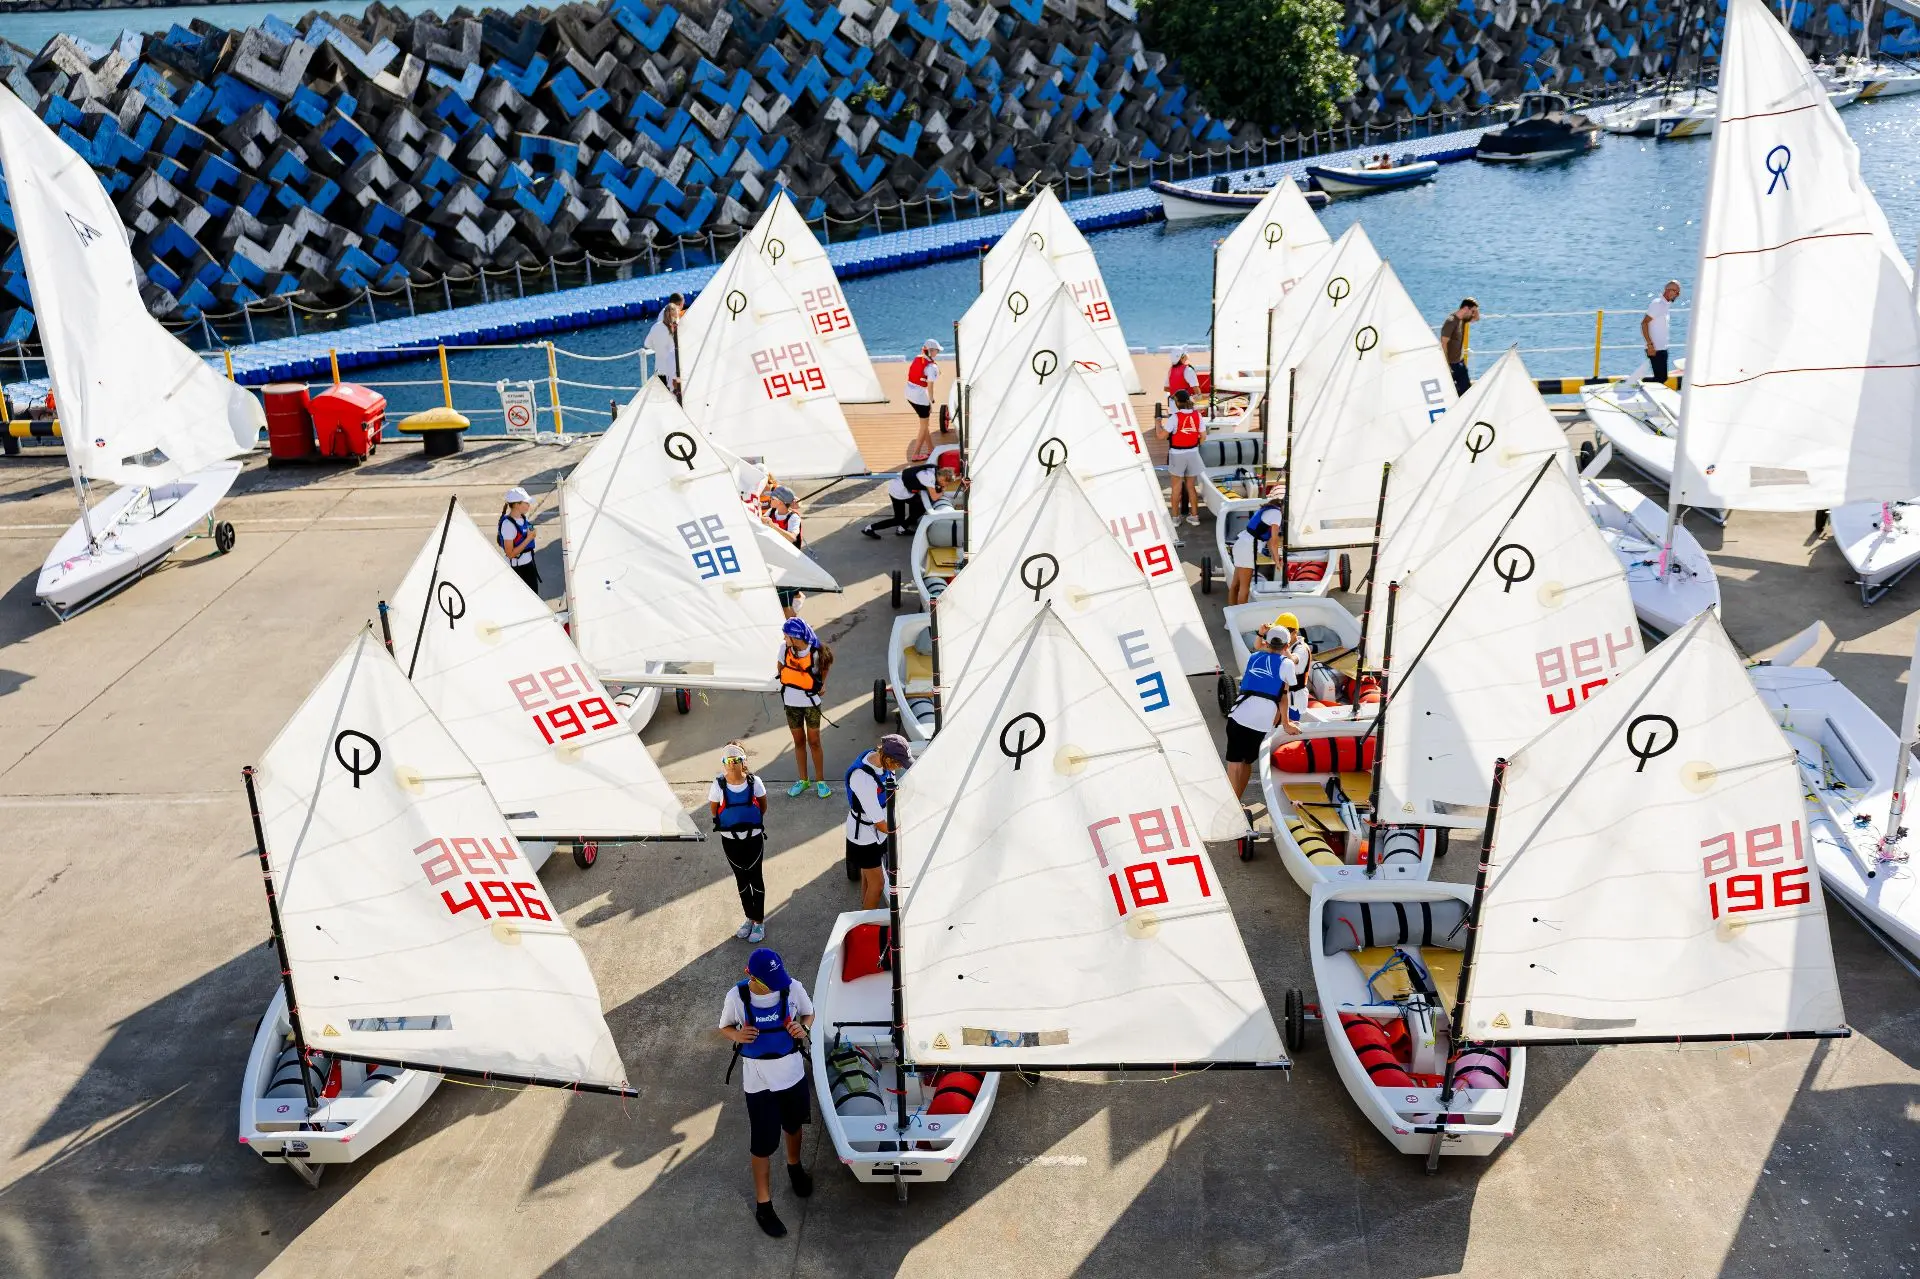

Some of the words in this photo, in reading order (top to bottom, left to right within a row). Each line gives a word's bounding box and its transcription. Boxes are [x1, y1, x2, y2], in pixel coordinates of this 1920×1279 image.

[810, 307, 851, 335] 195
[763, 367, 827, 400] 1949
[692, 545, 740, 580] 98
[1135, 671, 1170, 713] 3
[532, 696, 619, 745] 199
[440, 880, 552, 922] 496
[1108, 854, 1212, 917] 187
[1708, 865, 1811, 921] 196
